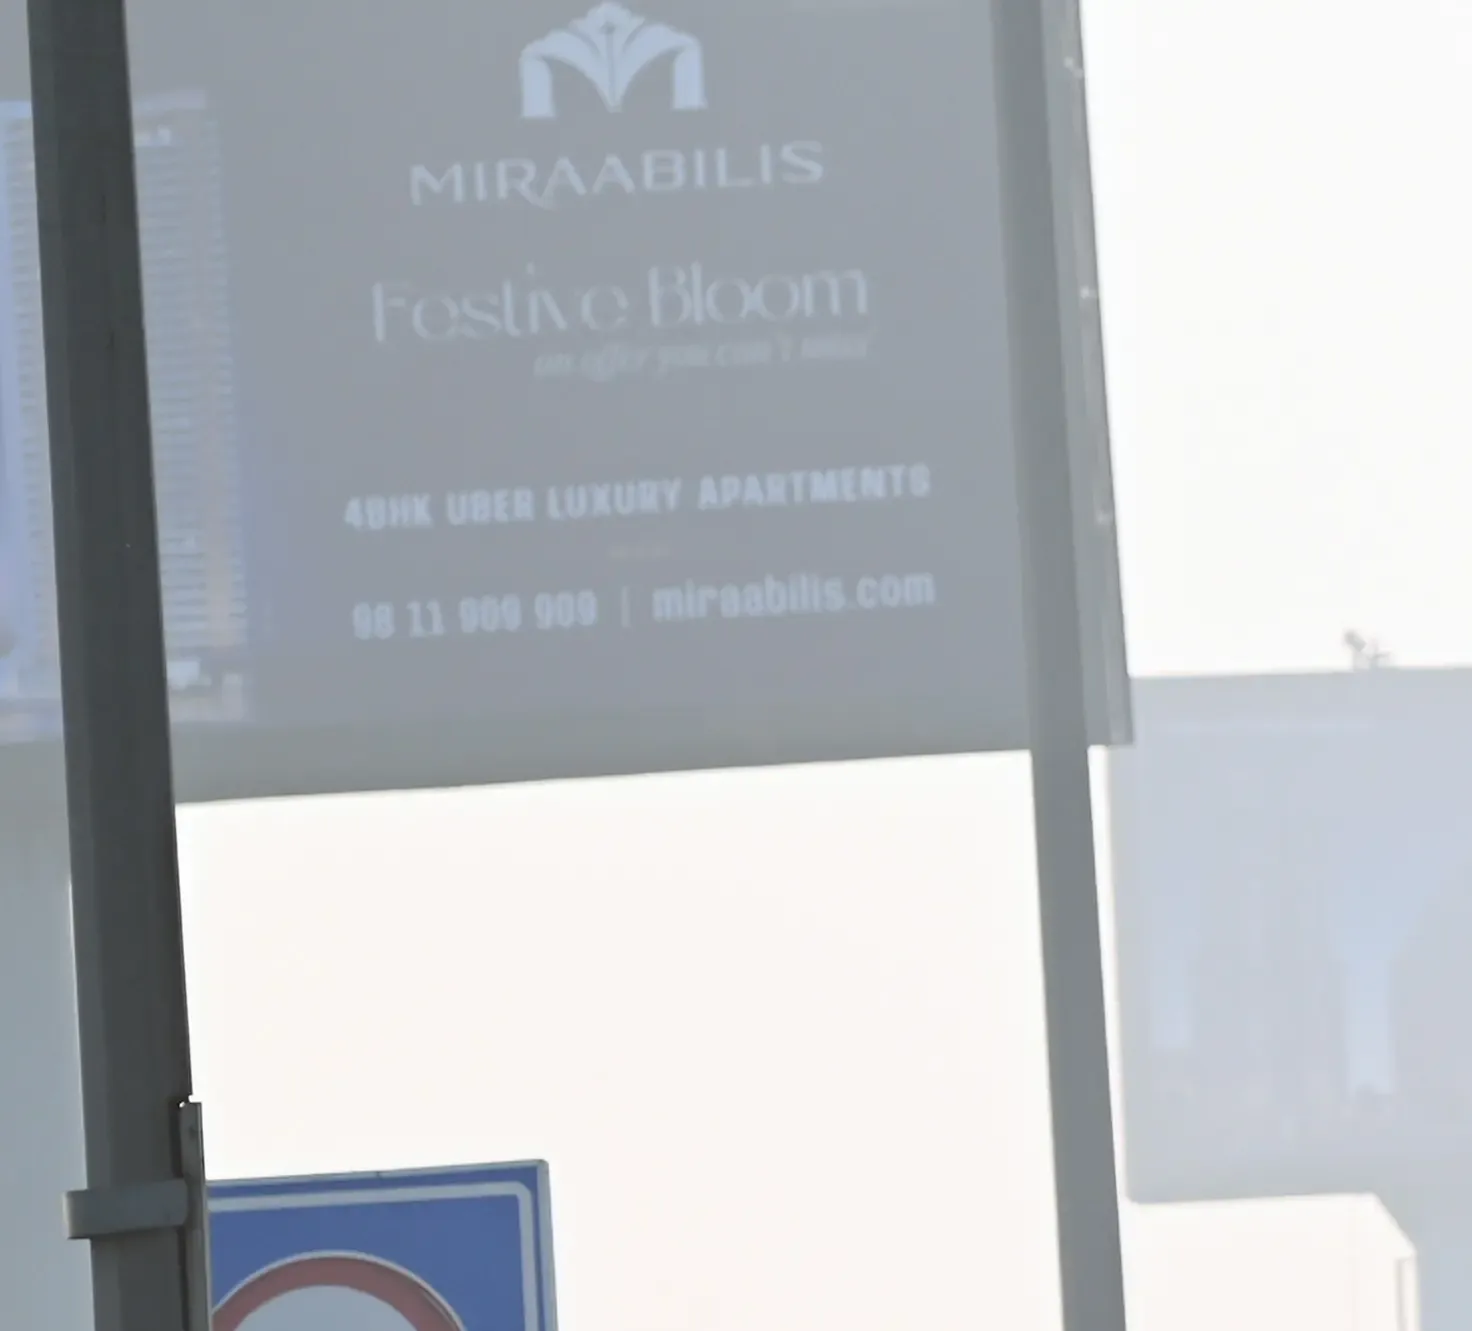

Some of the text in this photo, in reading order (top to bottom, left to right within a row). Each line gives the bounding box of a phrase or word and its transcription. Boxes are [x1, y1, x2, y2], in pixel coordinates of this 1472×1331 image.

[408, 140, 825, 209] MIRAABILIS
[371, 260, 870, 344] Festive Bloom
[444, 484, 536, 526] UBER
[546, 475, 683, 522] LUXURY
[697, 462, 933, 511] APARTMENTS
[406, 599, 444, 639] 11
[651, 570, 937, 625] miraabilis.com
